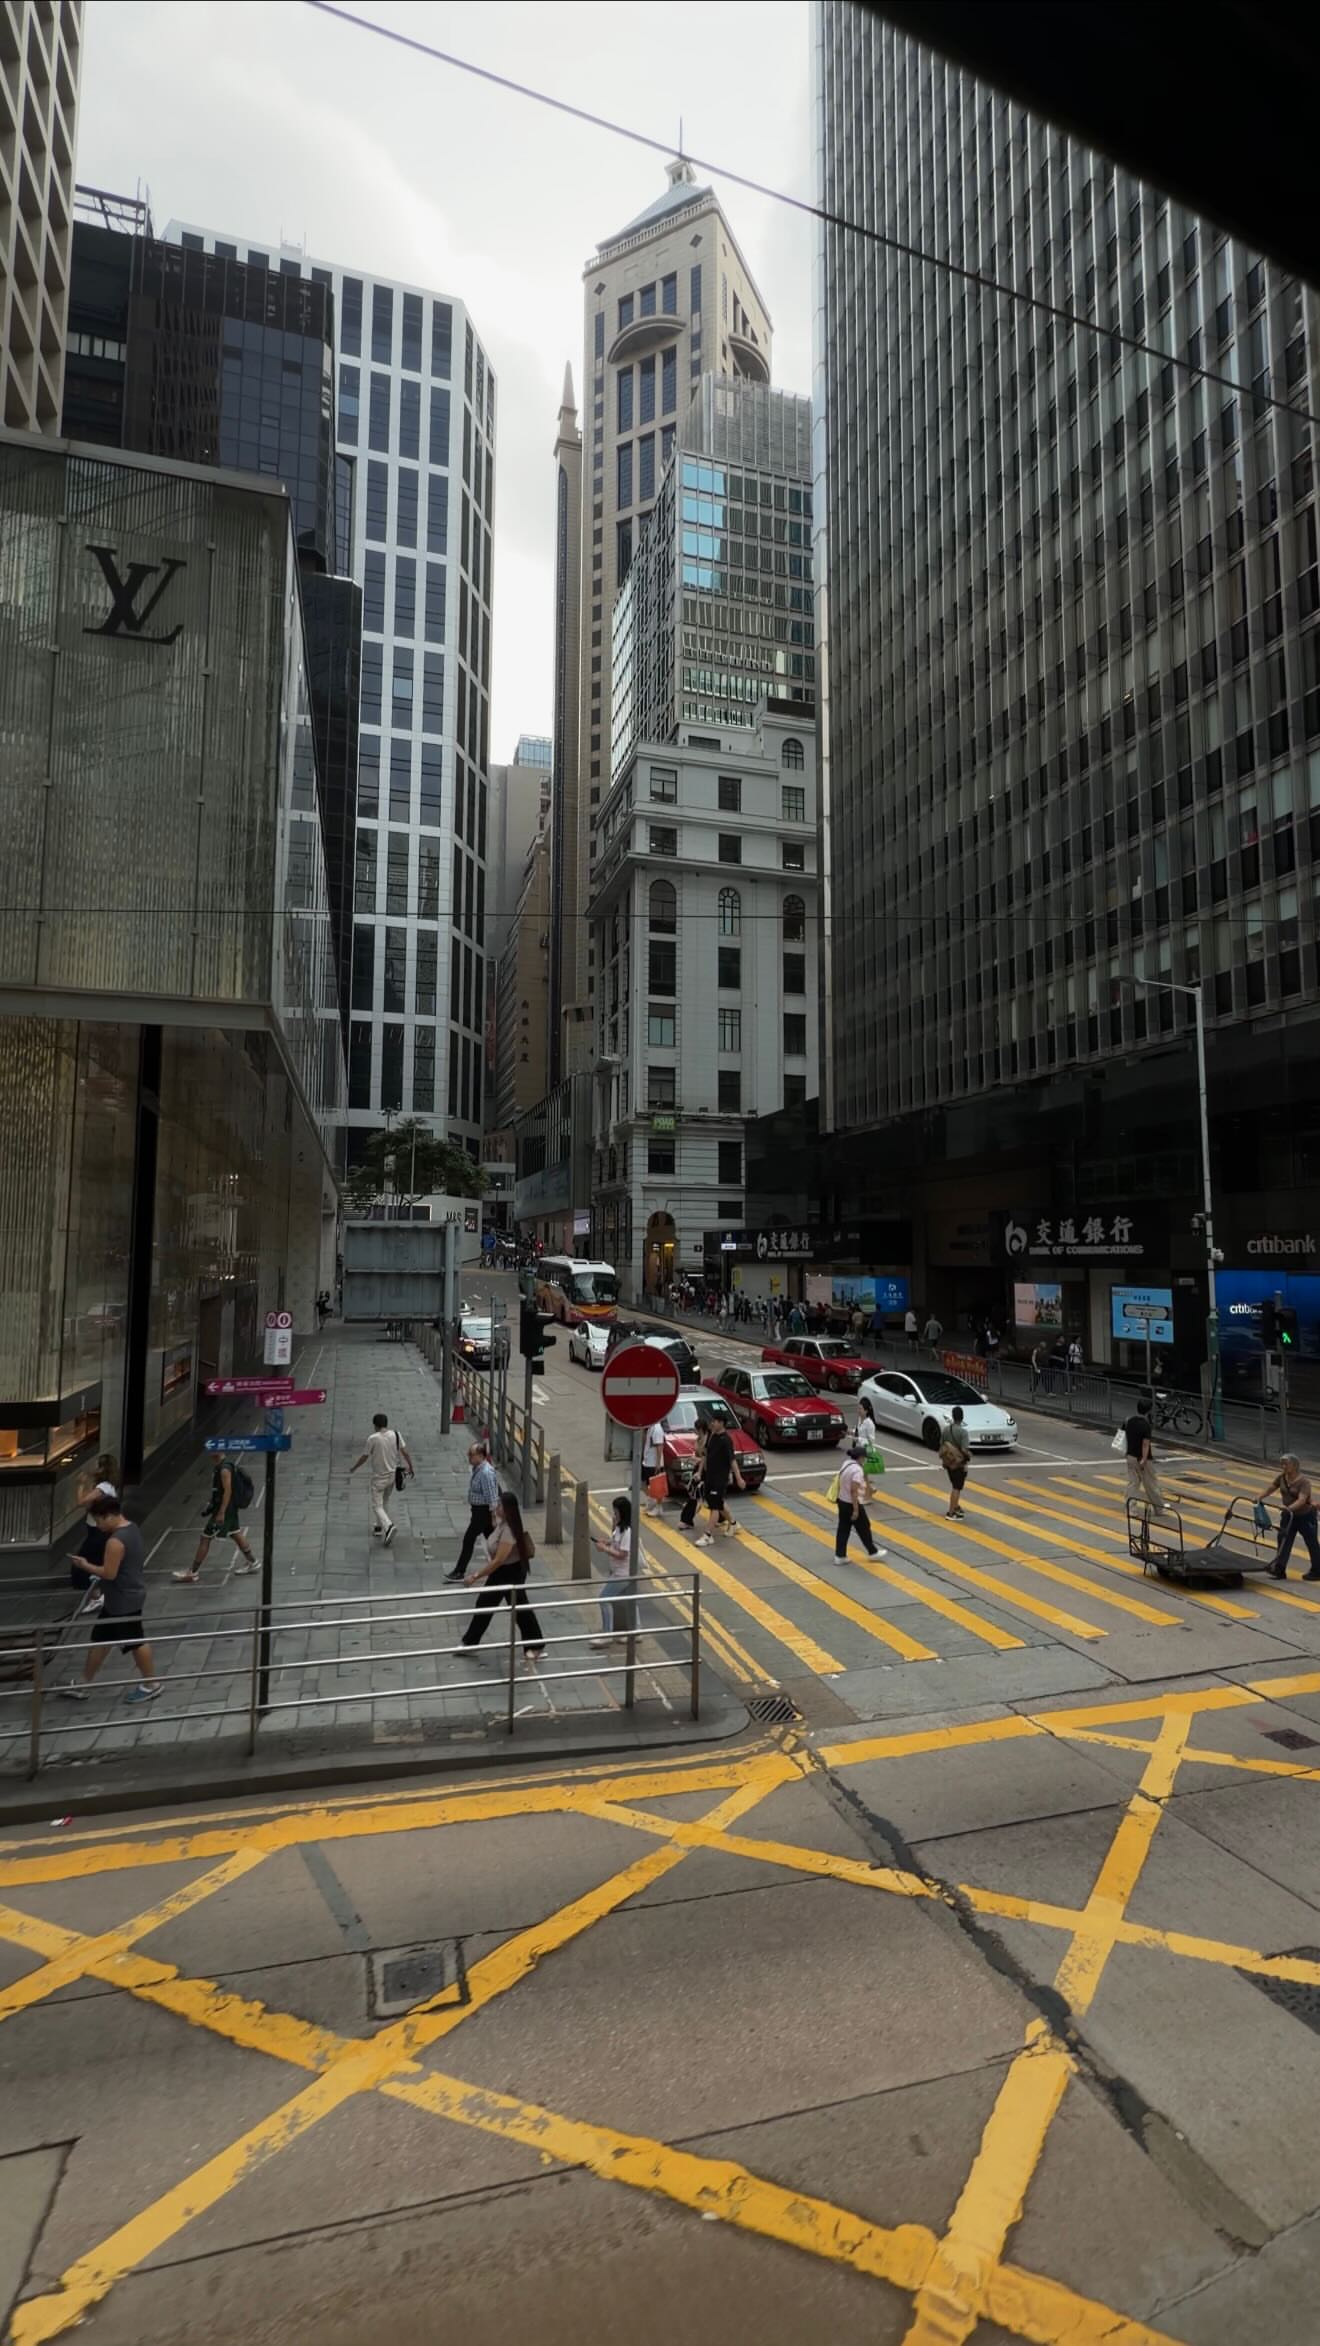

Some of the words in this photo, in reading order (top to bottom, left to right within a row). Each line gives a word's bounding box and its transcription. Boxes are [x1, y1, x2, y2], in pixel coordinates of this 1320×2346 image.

[1035, 1216, 1134, 1245] 交通銀行
[1246, 1233, 1317, 1254] citibank
